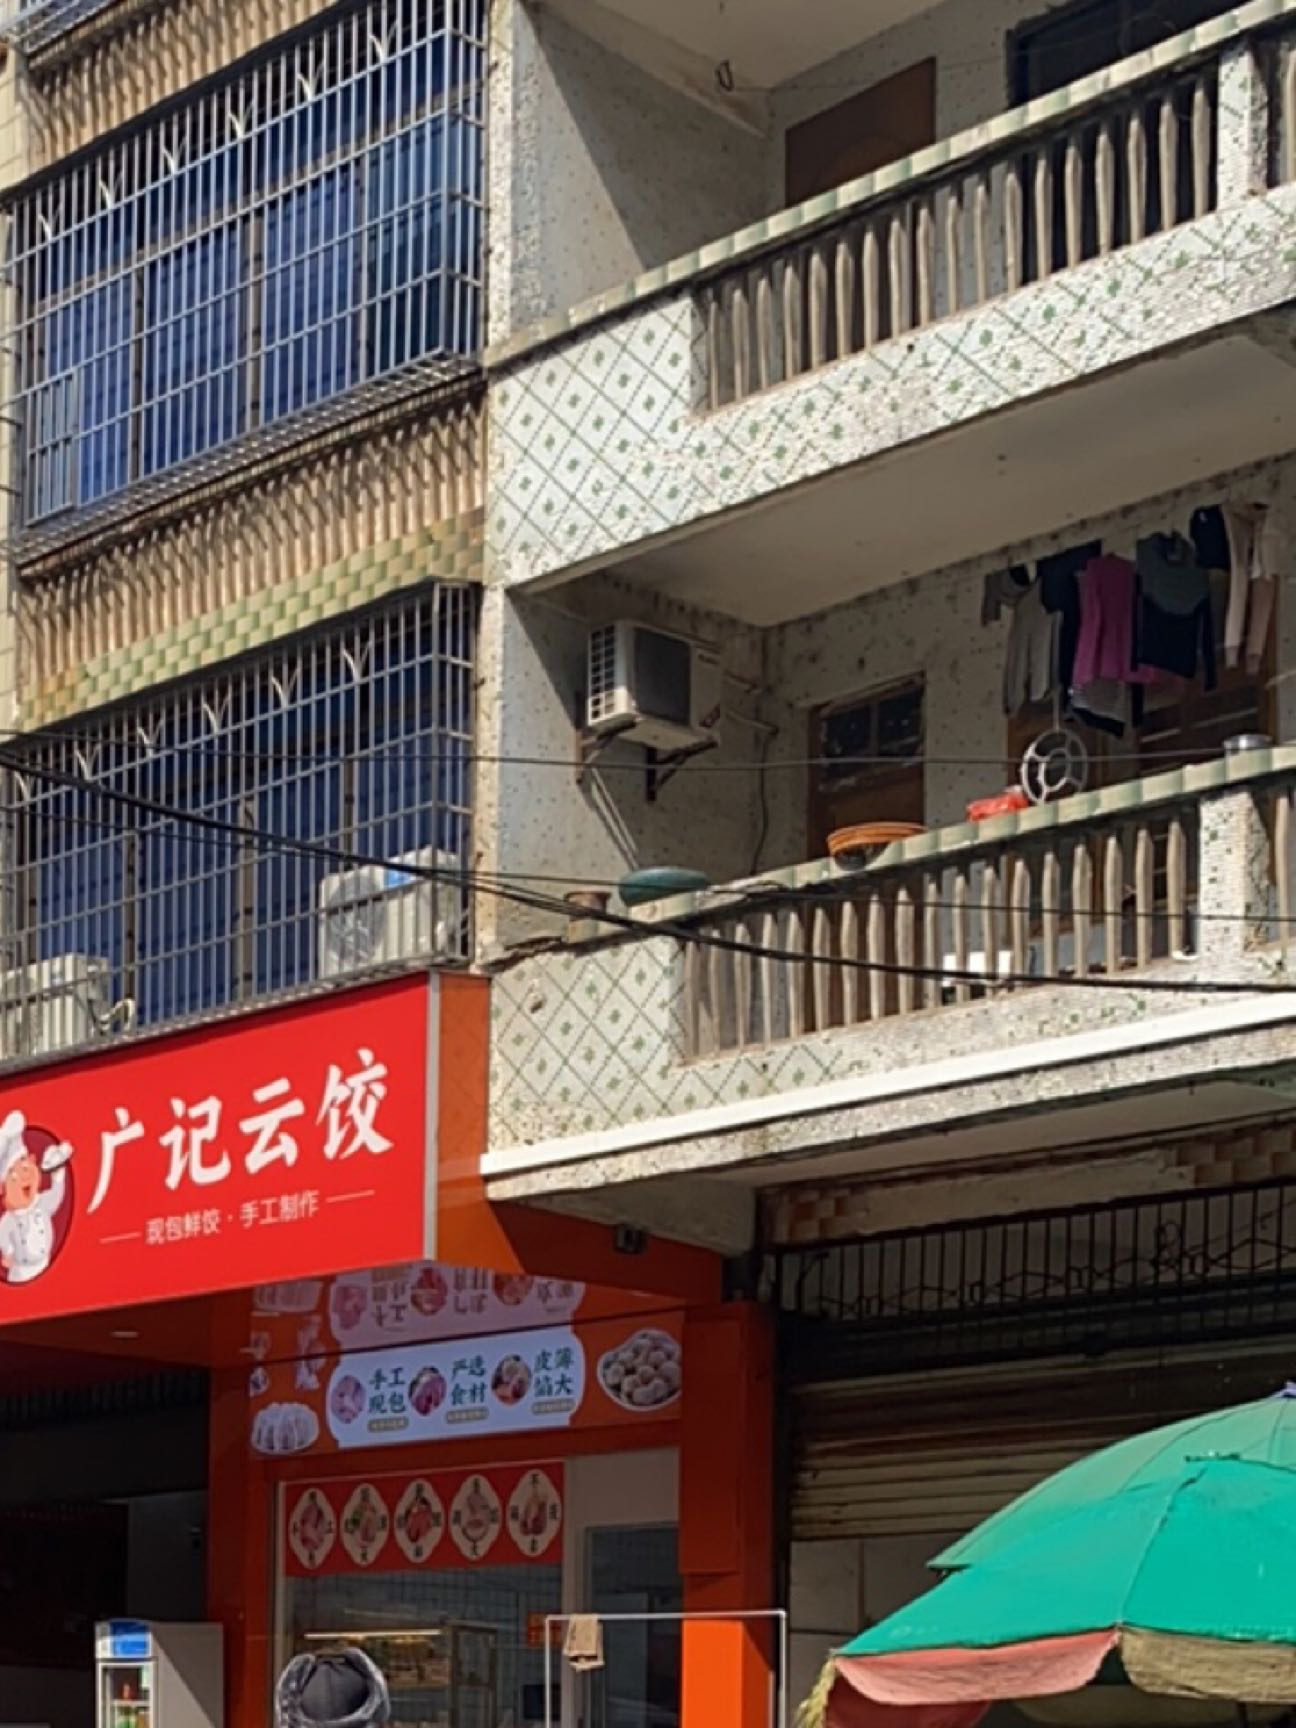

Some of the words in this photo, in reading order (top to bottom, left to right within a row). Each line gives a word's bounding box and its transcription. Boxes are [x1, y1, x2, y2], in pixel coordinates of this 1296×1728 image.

[87, 1047, 394, 1215] 广记云饺
[369, 1367, 406, 1390] 手工
